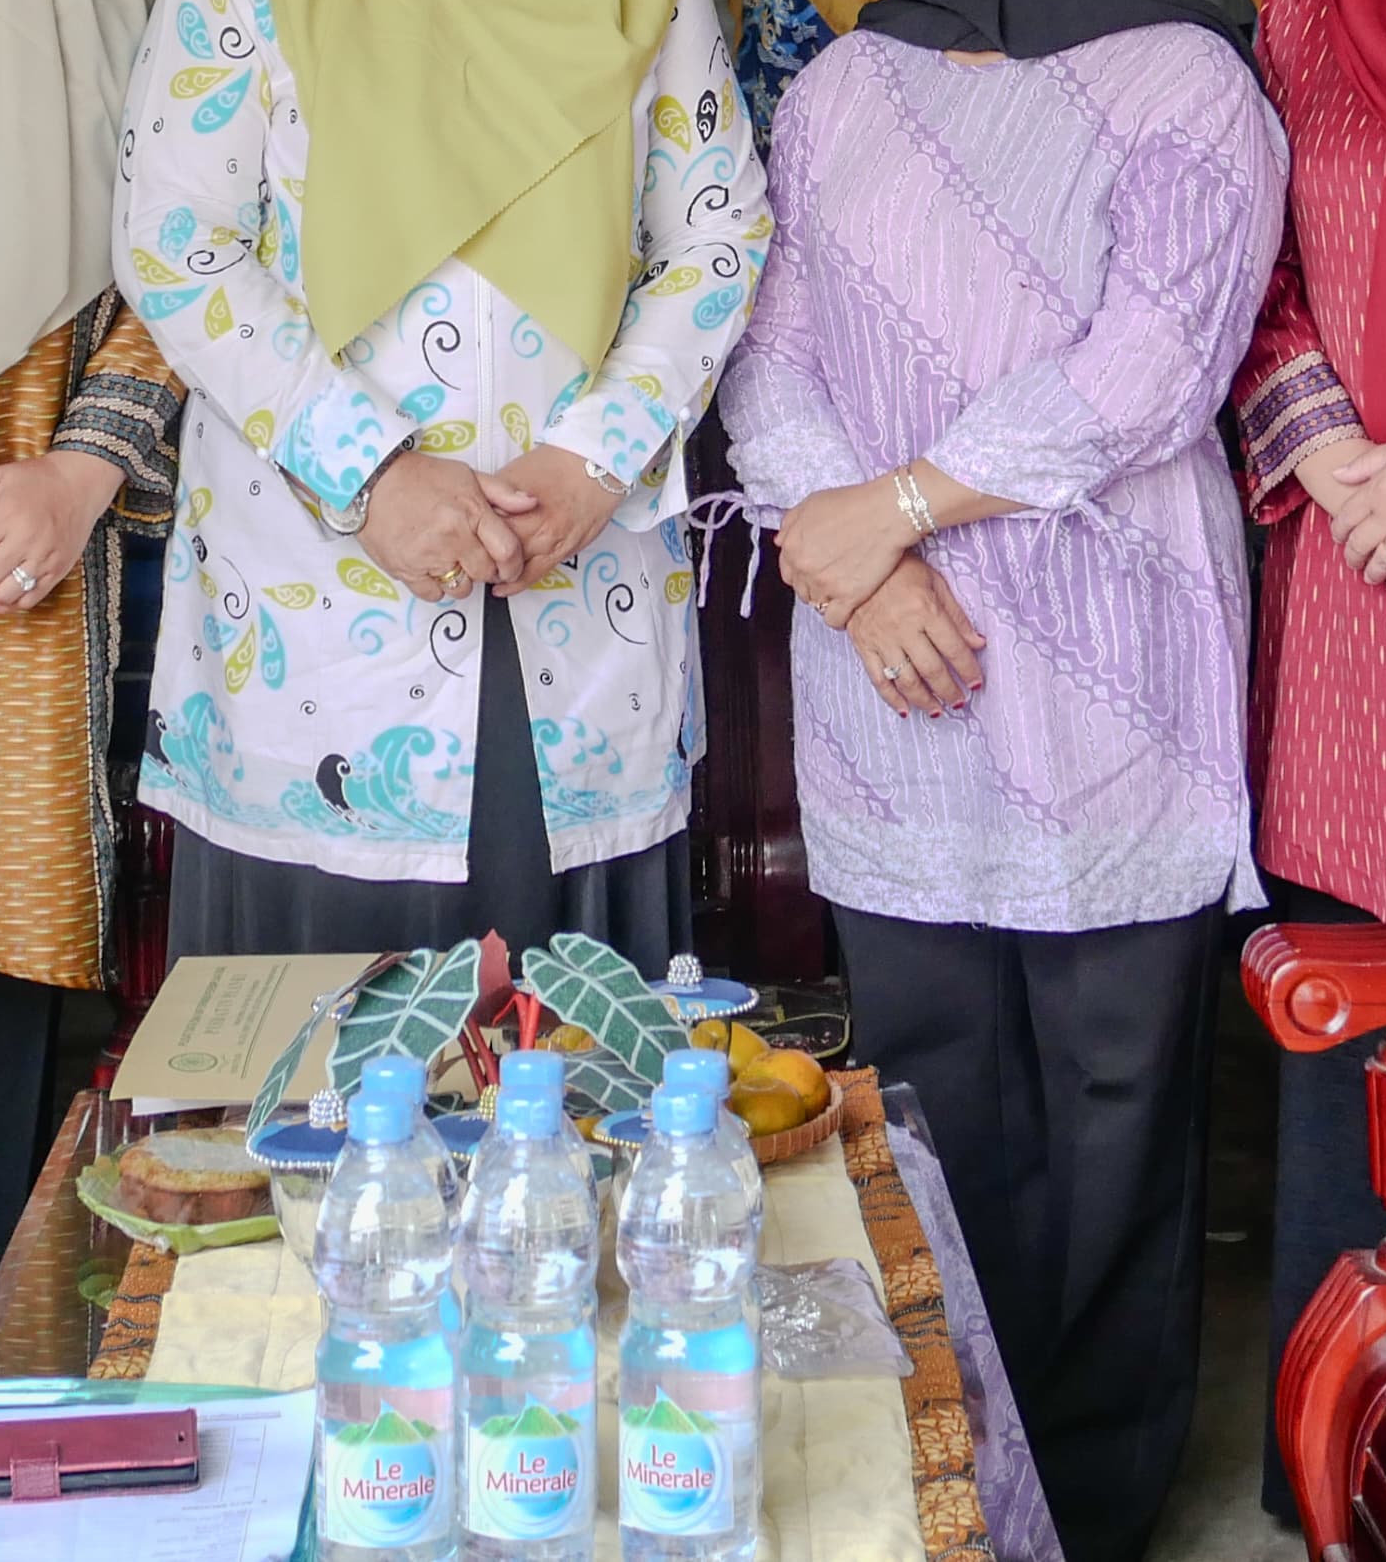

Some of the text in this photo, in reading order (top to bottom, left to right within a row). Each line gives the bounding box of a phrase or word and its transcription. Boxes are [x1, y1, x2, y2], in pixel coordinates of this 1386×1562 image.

[375, 1458, 402, 1481] Le
[519, 1452, 546, 1476] Le
[651, 1444, 677, 1469] Le
[486, 1467, 577, 1495] Minerale
[627, 1456, 714, 1489] Minerale
[343, 1474, 436, 1502] Minerale
